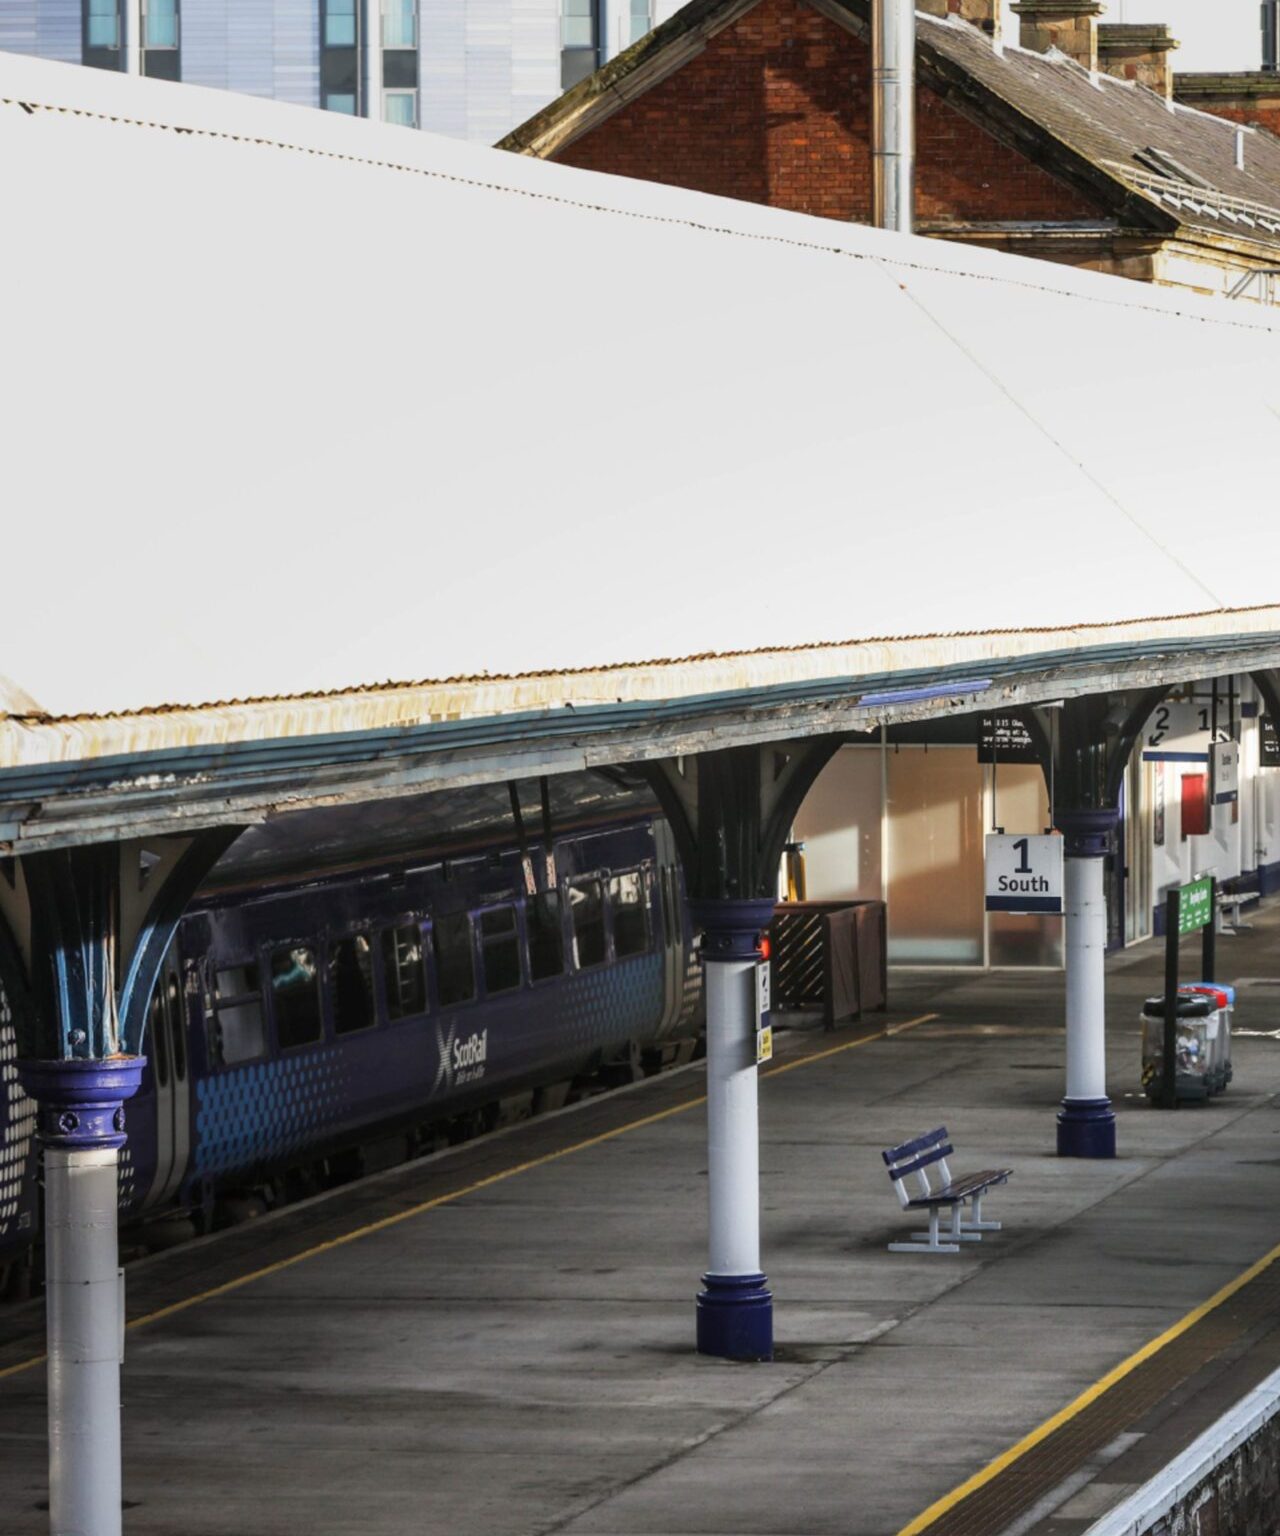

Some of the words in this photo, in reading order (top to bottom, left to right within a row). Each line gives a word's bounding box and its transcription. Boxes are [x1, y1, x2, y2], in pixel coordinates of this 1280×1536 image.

[1156, 707, 1169, 730] 2
[1198, 708, 1210, 731] 1
[1012, 838, 1033, 873] 1
[998, 875, 1049, 892] South
[453, 1027, 488, 1070] ScotRail
